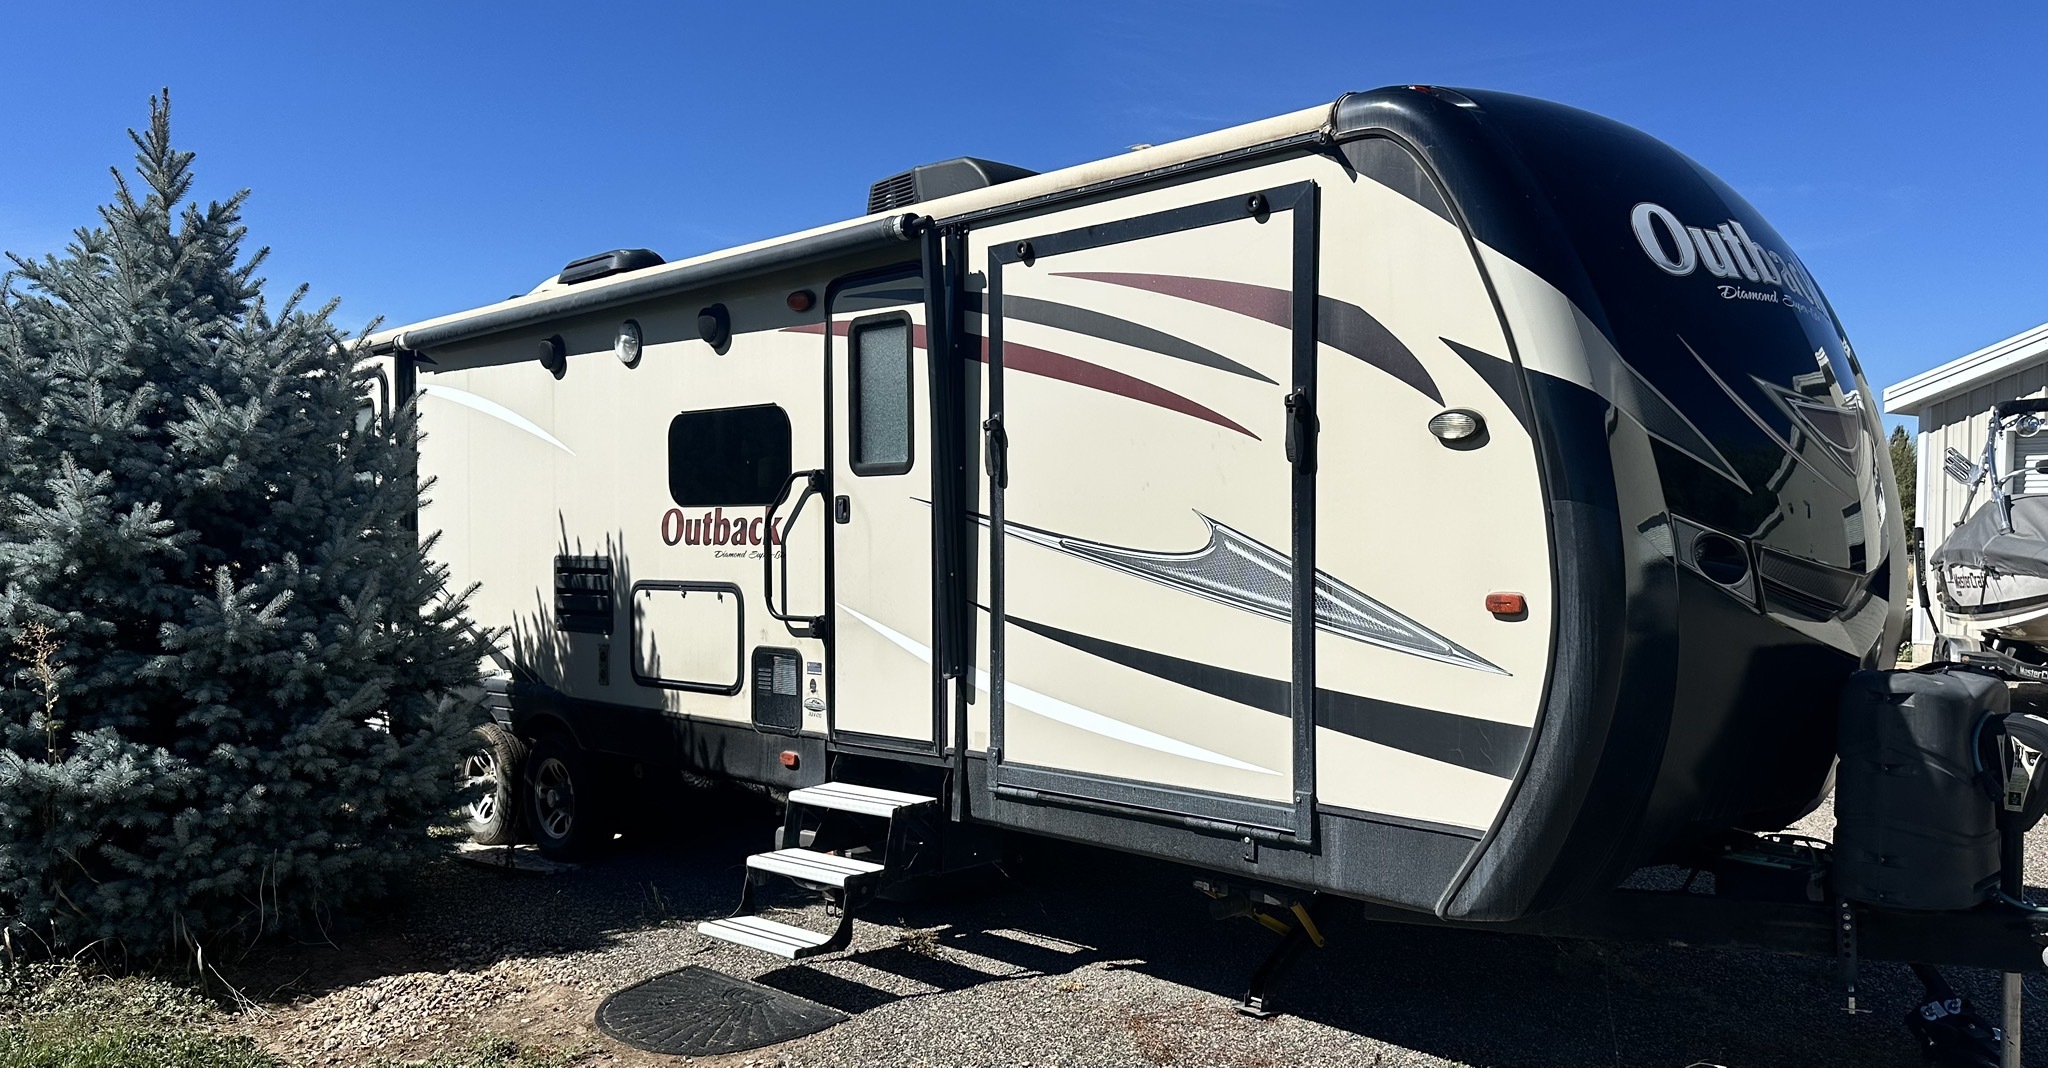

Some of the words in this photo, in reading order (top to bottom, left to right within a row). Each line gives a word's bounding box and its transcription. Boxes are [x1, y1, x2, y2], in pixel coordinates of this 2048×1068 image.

[1717, 285, 1778, 303] Diamond
[661, 506, 783, 546] Outback
[714, 550, 747, 559] Diamond
